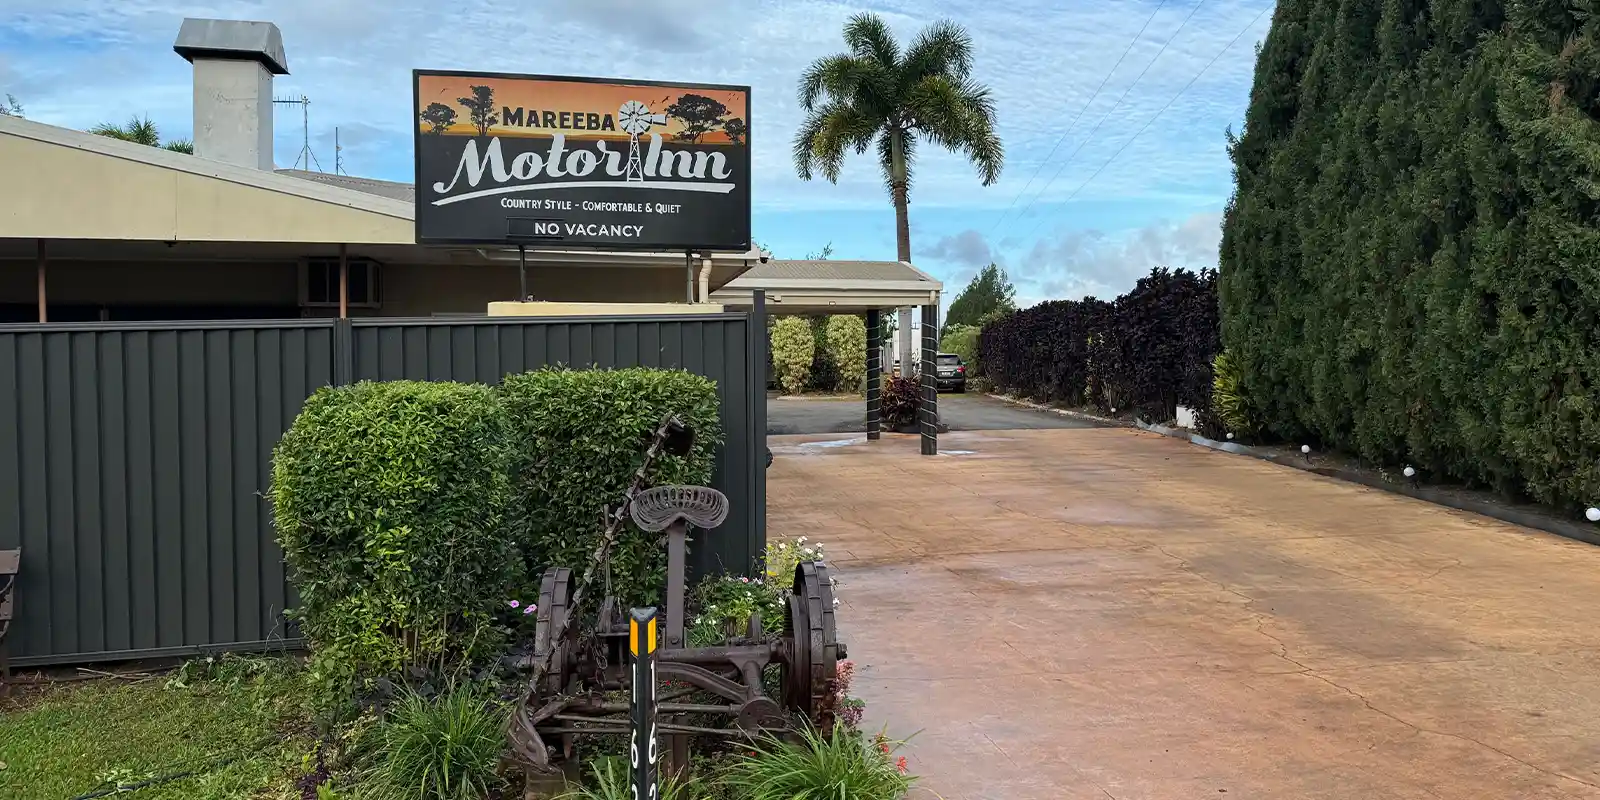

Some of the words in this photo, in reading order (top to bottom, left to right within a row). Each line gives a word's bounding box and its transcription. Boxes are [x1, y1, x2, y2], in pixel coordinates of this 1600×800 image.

[502, 106, 616, 131] MAREEBA
[432, 133, 629, 194] Motor
[643, 133, 732, 180] Inn
[500, 197, 542, 210] COUNTRY
[544, 199, 572, 211] STYLE
[582, 200, 643, 213] COMFORTABLE
[645, 203, 653, 213] &
[655, 203, 681, 214] QUIET
[534, 222, 560, 235] NO
[564, 223, 644, 238] VACANCY
